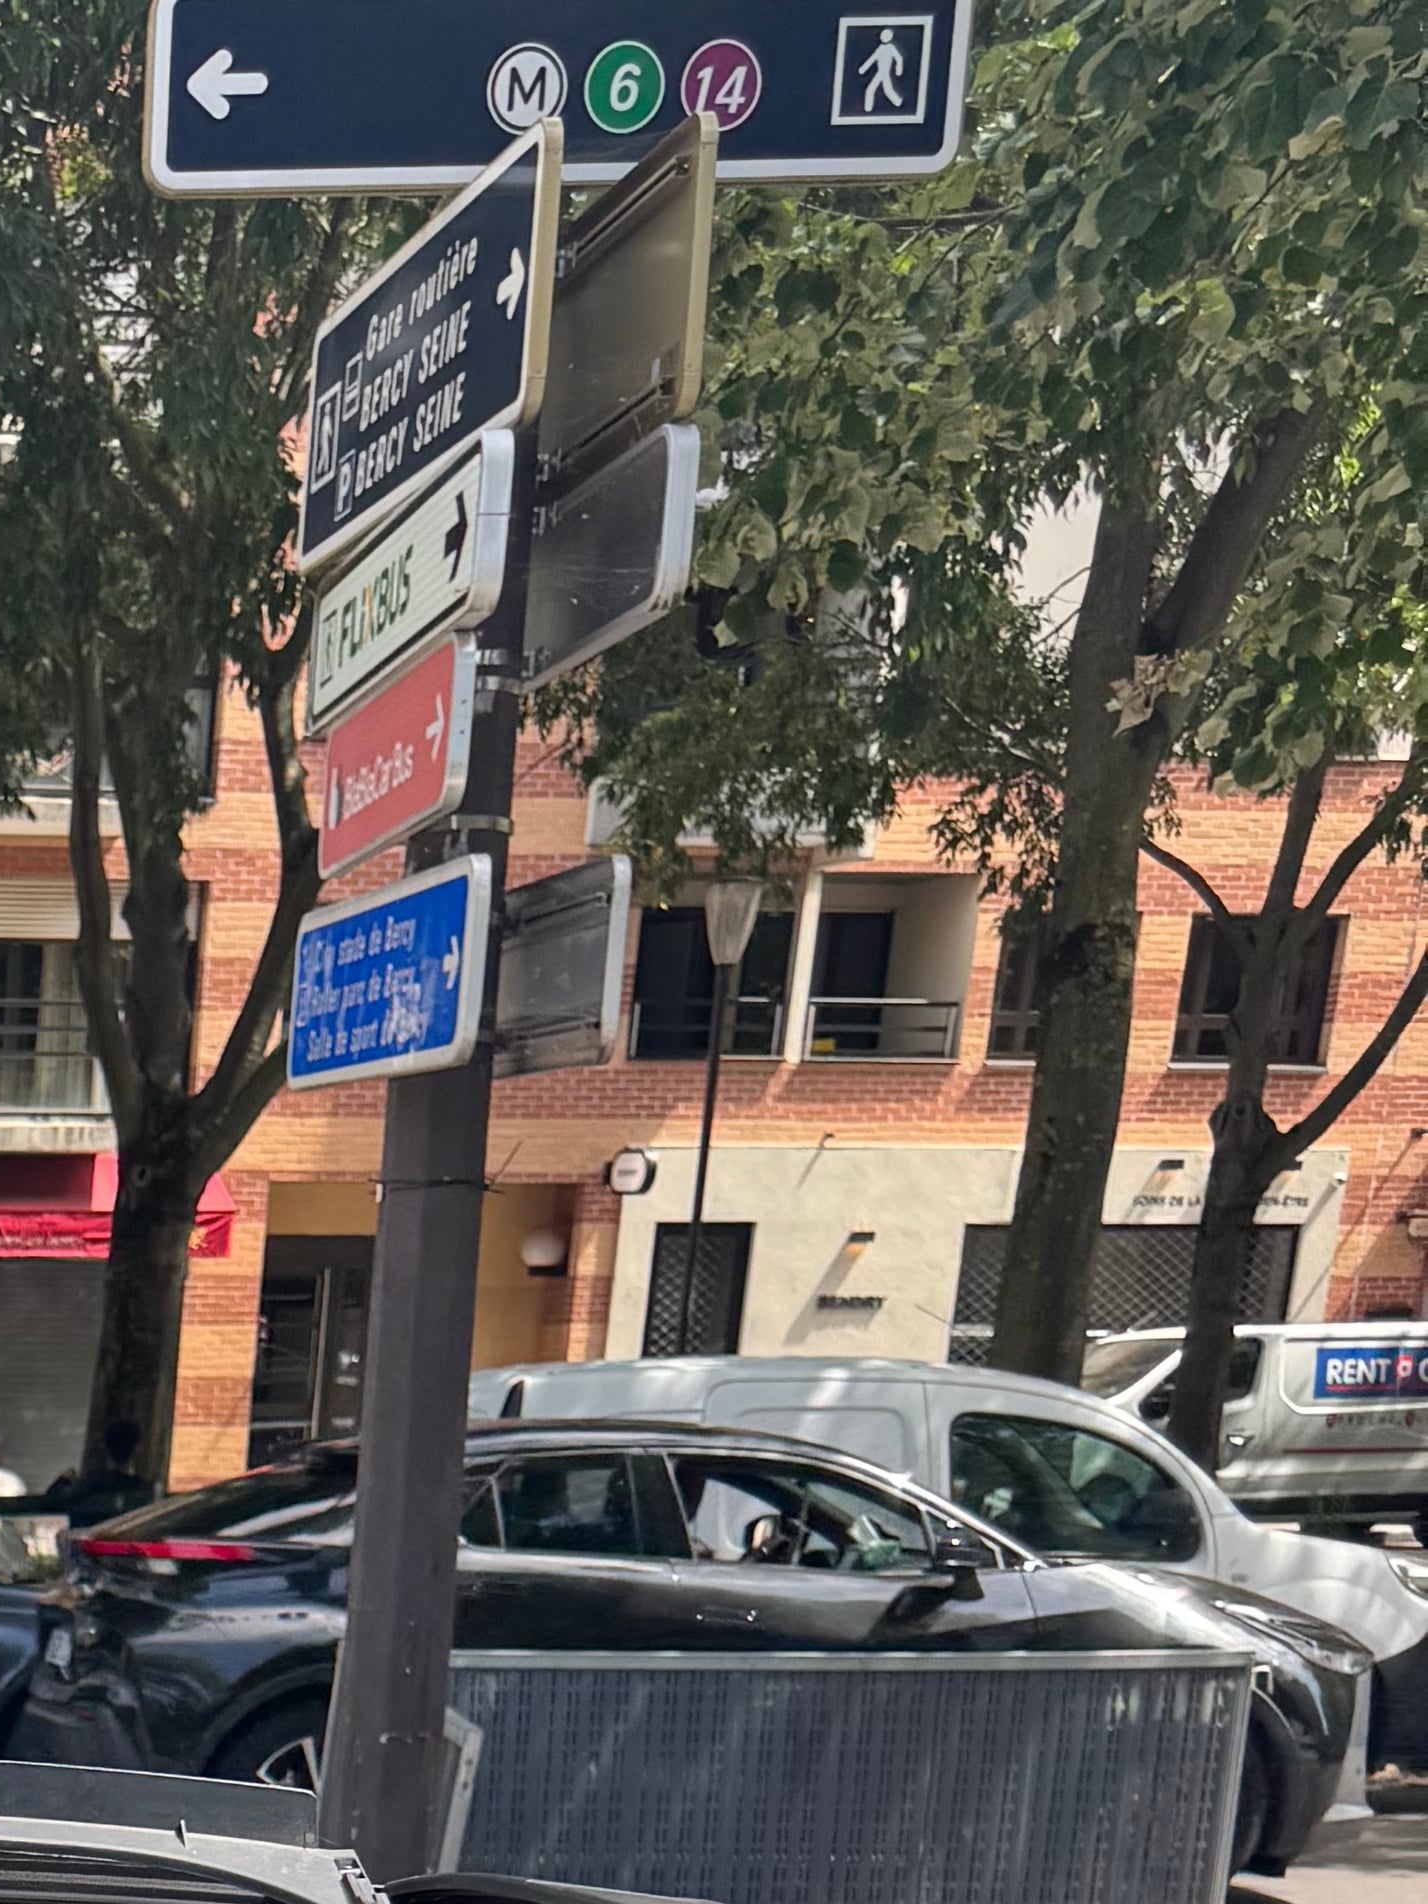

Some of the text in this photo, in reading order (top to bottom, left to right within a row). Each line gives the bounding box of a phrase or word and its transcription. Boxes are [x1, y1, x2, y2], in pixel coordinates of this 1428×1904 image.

[506, 64, 748, 115] M 6 14
[366, 236, 478, 362] Gare routière
[359, 300, 472, 432] BERCY SEINE
[354, 416, 409, 497] BERCY
[412, 371, 466, 453] SEINE
[338, 544, 414, 669] FLIXBUS
[1326, 1357, 1392, 1386] RENT
